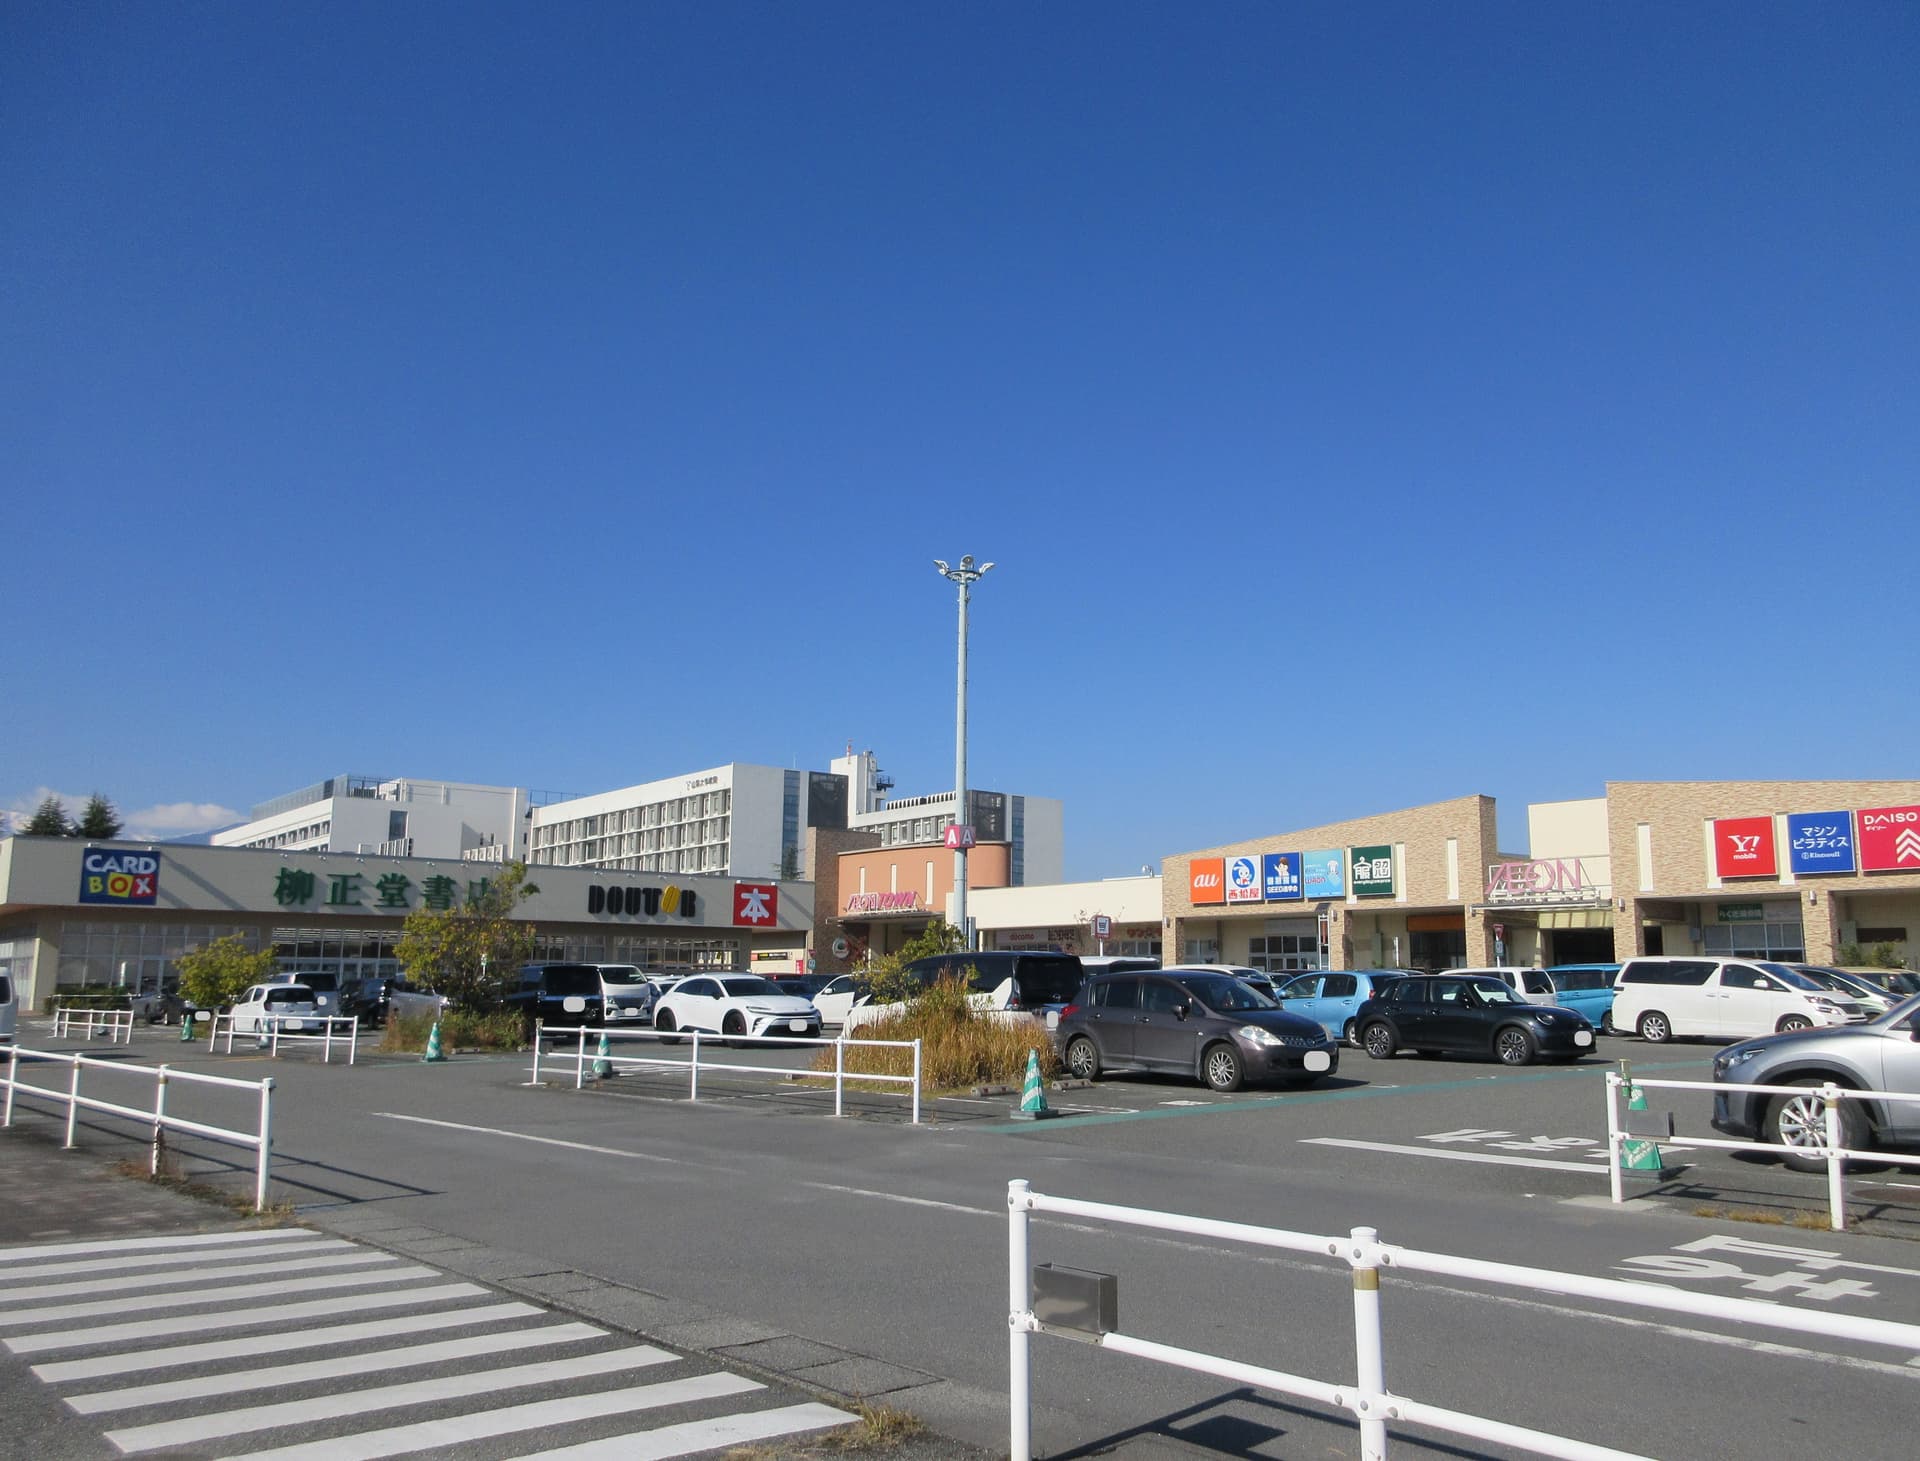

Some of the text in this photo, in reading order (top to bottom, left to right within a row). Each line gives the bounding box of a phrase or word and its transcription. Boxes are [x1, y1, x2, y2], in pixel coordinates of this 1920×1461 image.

[1864, 812, 1918, 825] DAISO
[947, 828, 957, 848] A
[962, 828, 973, 848] A
[1801, 826, 1837, 836] マシン
[1728, 835, 1760, 852] Y!
[1793, 837, 1849, 850] ピラティス
[86, 854, 157, 874] CARD
[88, 876, 152, 894] BOX
[1193, 874, 1219, 888] au
[588, 884, 697, 917] DOUTOR
[1228, 888, 1260, 900] 西松屋
[740, 888, 770, 923] 本
